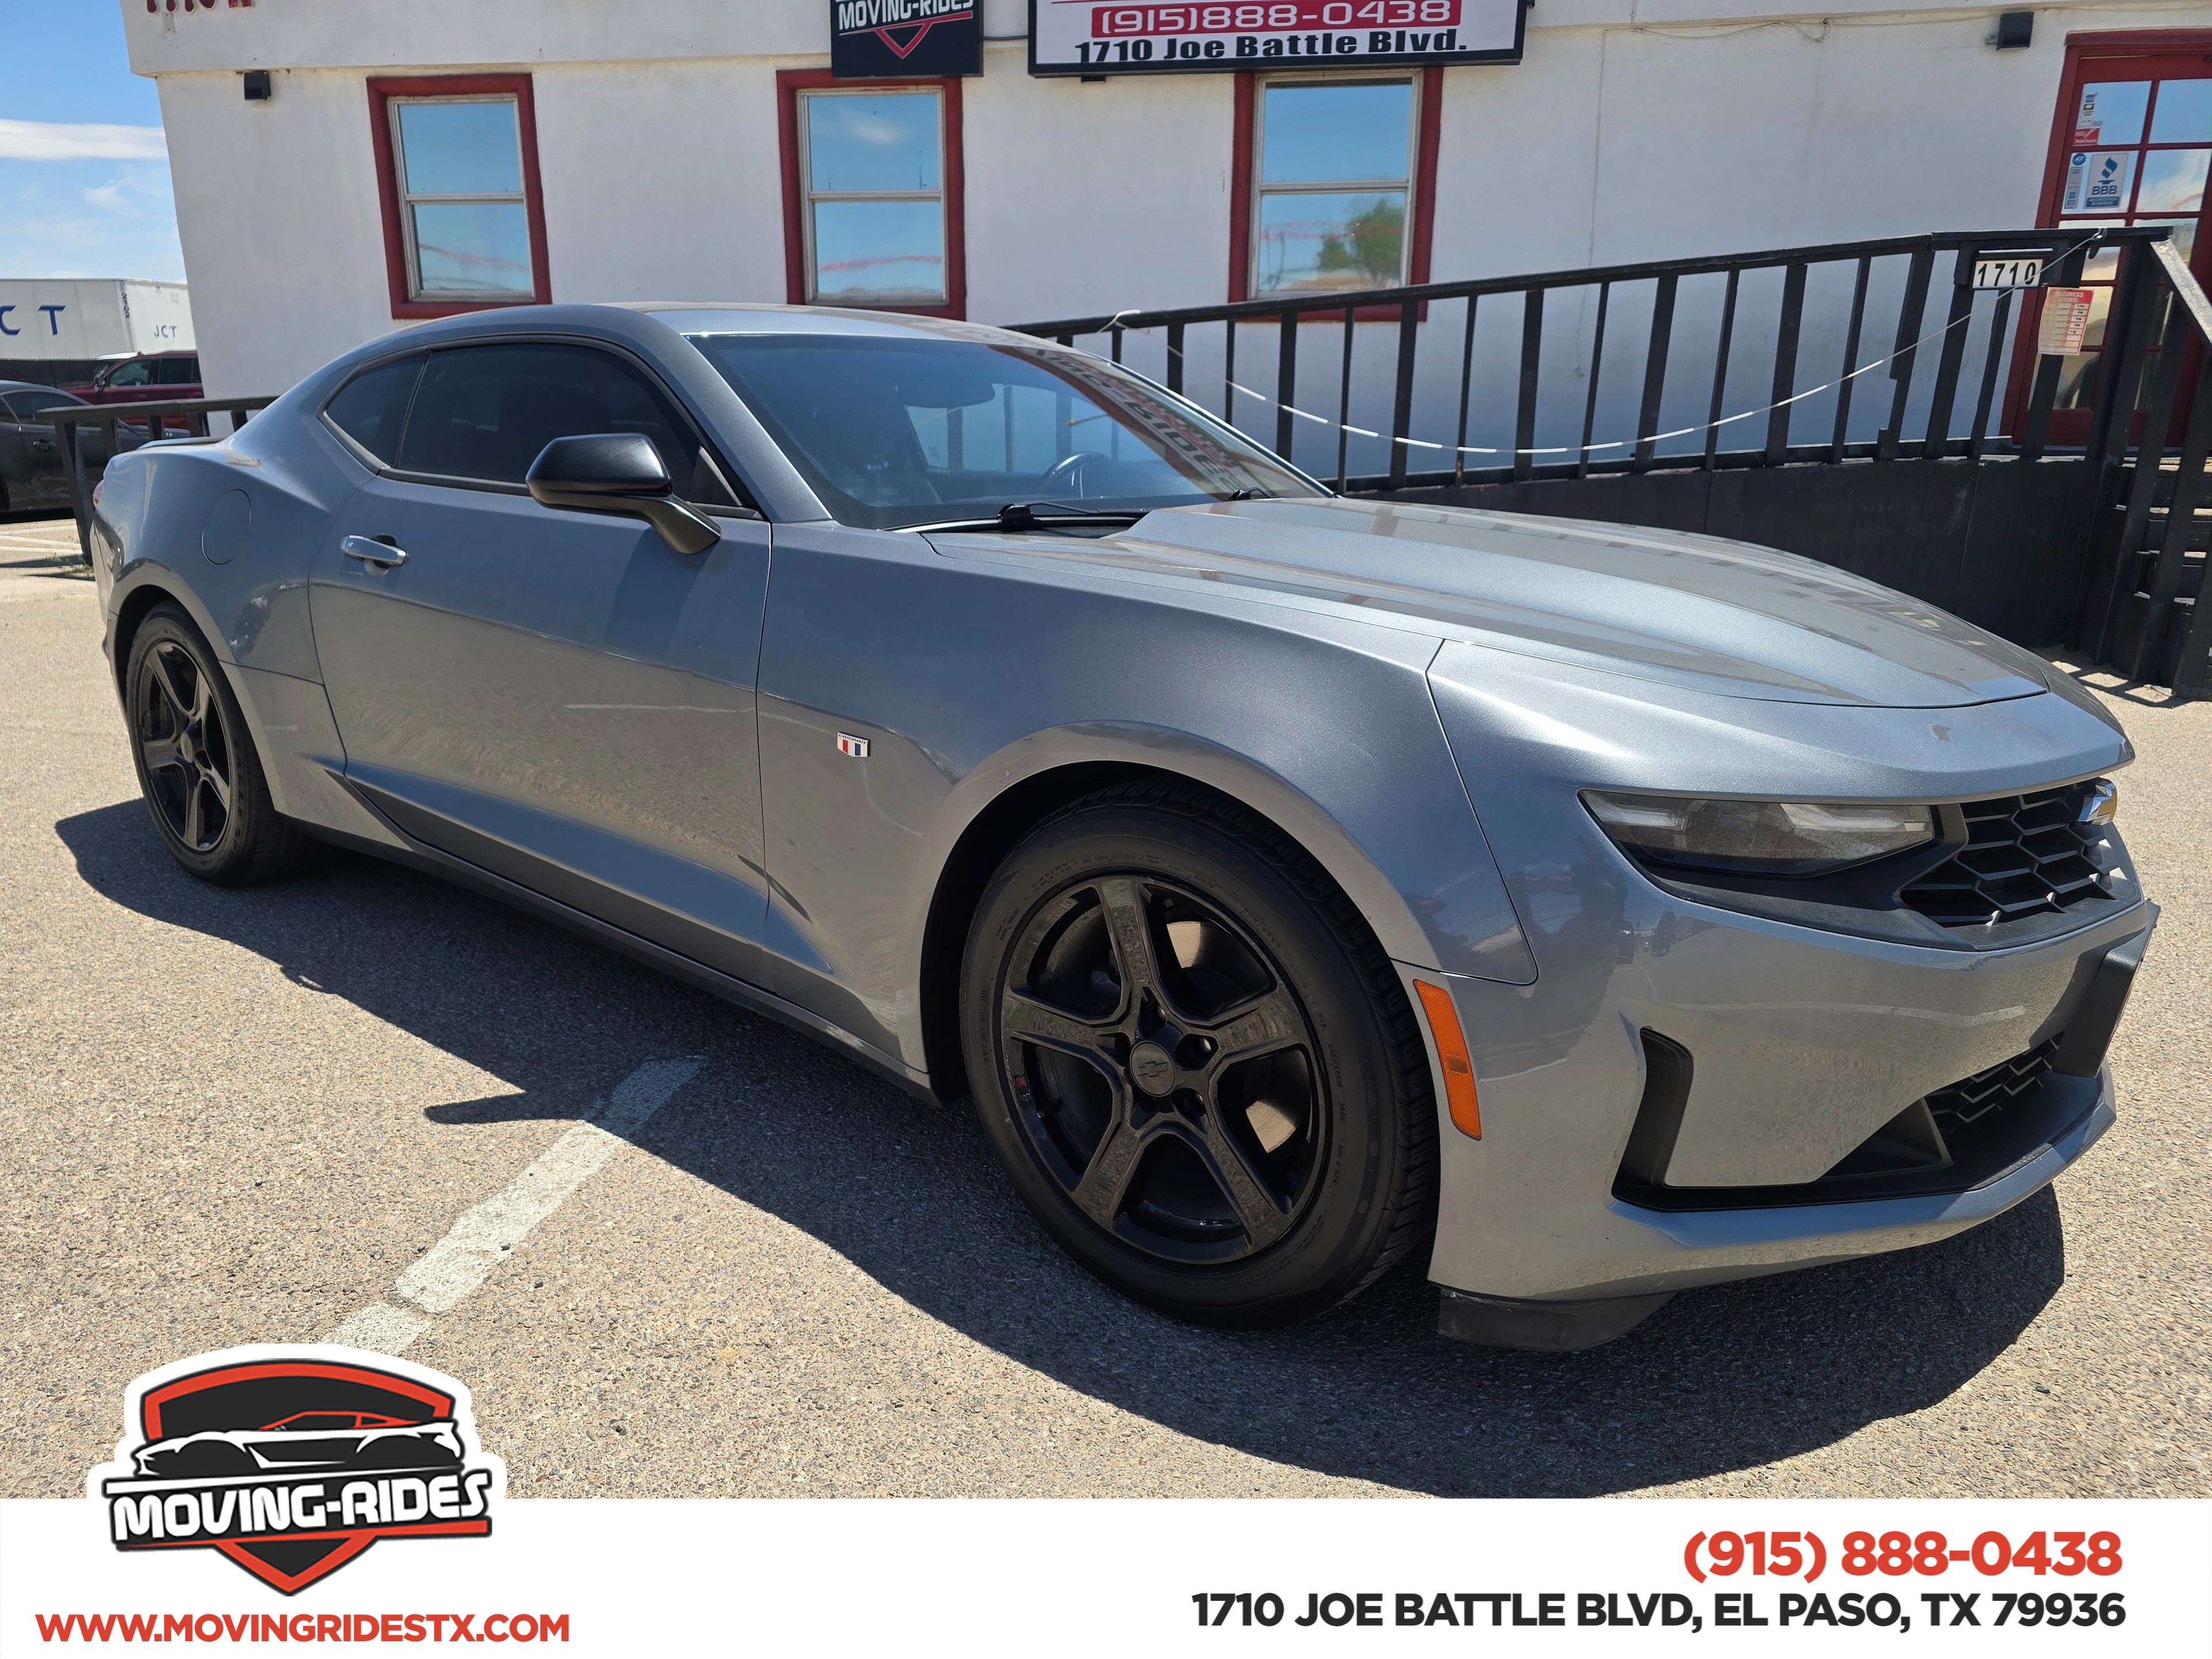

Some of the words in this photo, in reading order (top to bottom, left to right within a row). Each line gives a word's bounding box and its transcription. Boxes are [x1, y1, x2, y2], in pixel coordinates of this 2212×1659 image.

[1101, 0, 1451, 33] (915)888-0438
[1074, 39, 1153, 63] 1710
[1164, 38, 1225, 59] Joe
[1236, 32, 1358, 58] Battle
[1368, 29, 1467, 53] Blvd.
[2091, 185, 2118, 195] BBB
[1978, 262, 2036, 286] 1710
[154, 324, 177, 339] JCT
[839, 733, 866, 744] CAMARO
